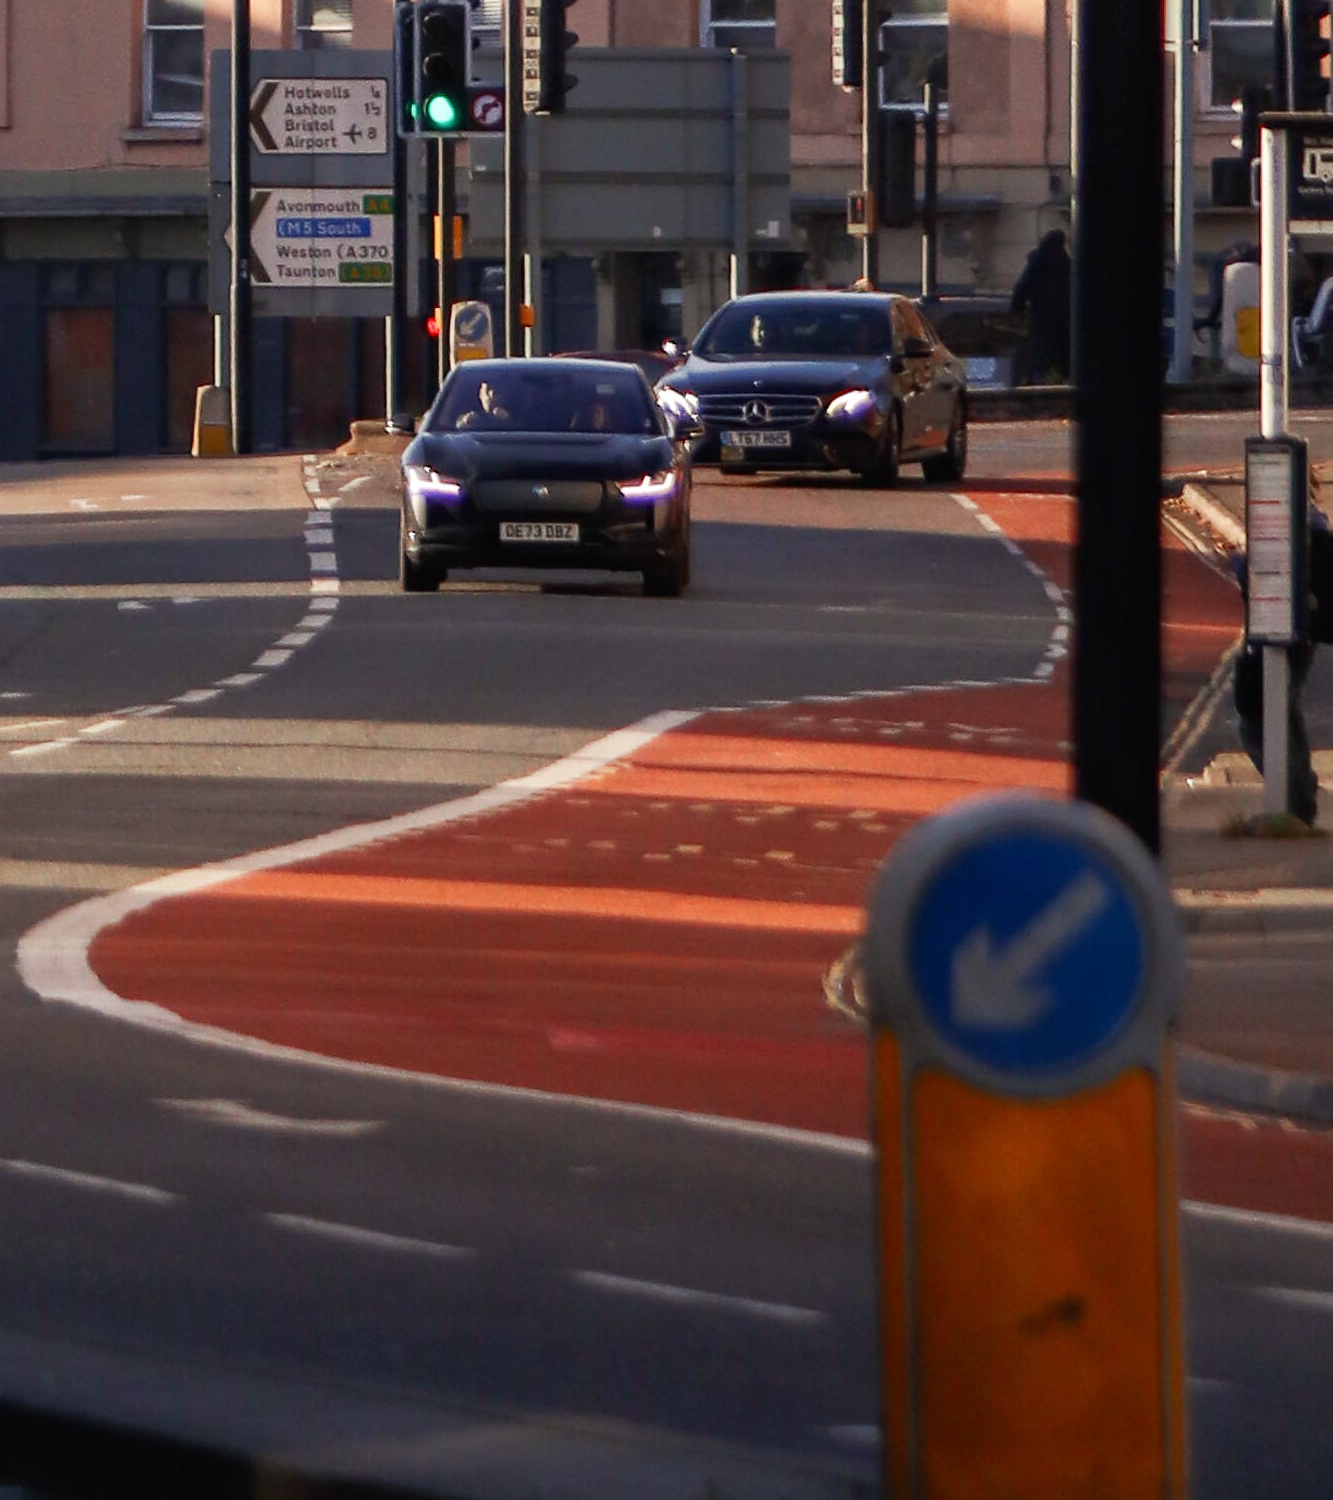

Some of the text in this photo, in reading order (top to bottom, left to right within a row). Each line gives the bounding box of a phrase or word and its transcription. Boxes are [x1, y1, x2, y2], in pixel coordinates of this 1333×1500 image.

[284, 85, 350, 99] Hotwells
[284, 102, 337, 116] Ashton
[284, 119, 335, 132] Bristol
[367, 126, 378, 140] 8
[284, 135, 338, 149] Airport
[276, 199, 361, 213] Avonmouth
[276, 245, 332, 258] Weston
[276, 264, 336, 278] Taunton
